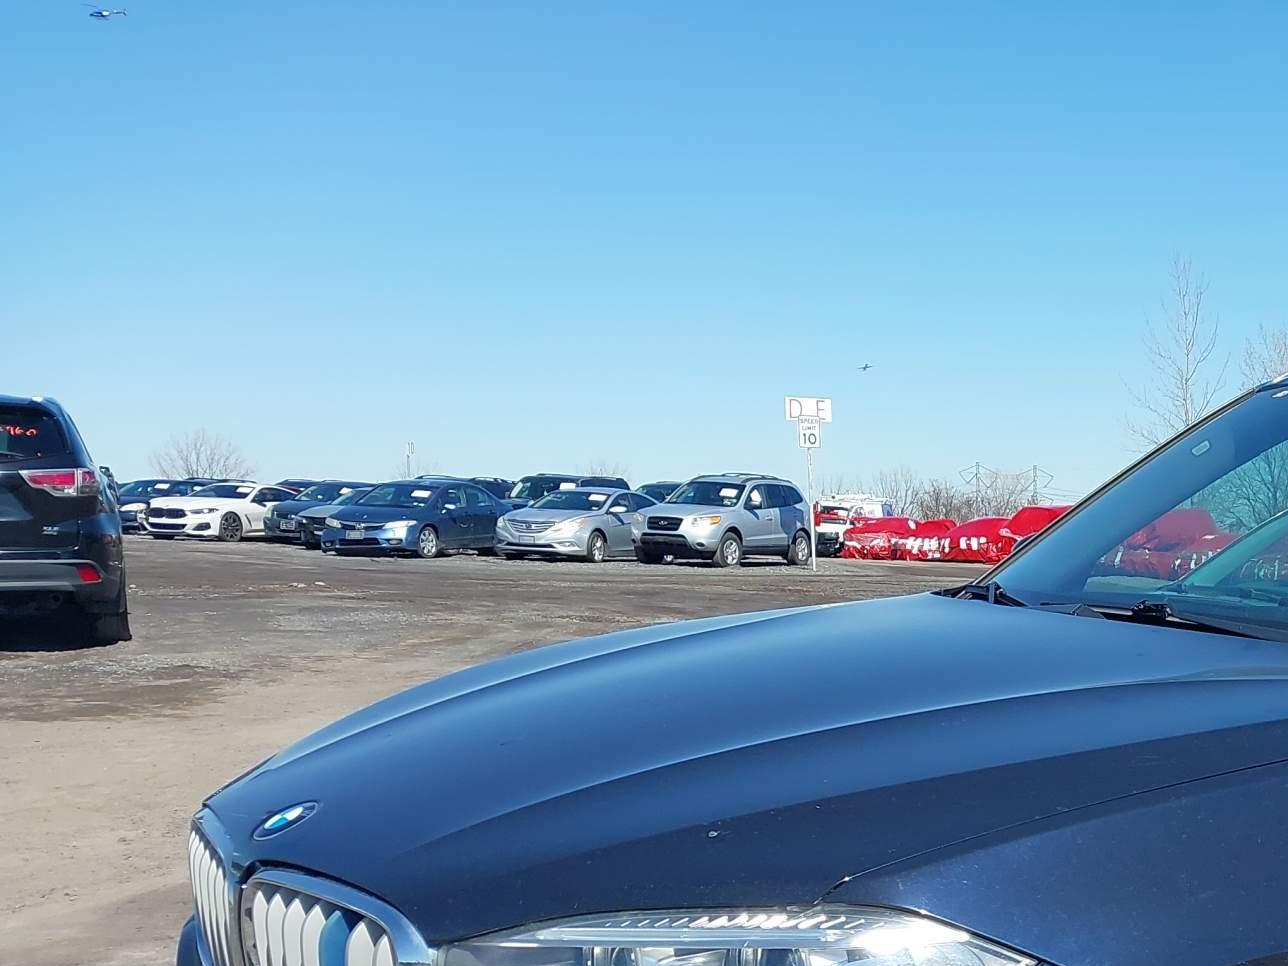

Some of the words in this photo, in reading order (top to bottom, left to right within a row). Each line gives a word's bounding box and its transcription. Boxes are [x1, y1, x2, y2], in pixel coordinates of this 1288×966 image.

[789, 398, 802, 419] D
[816, 400, 827, 420] E
[803, 433, 817, 445] 10
